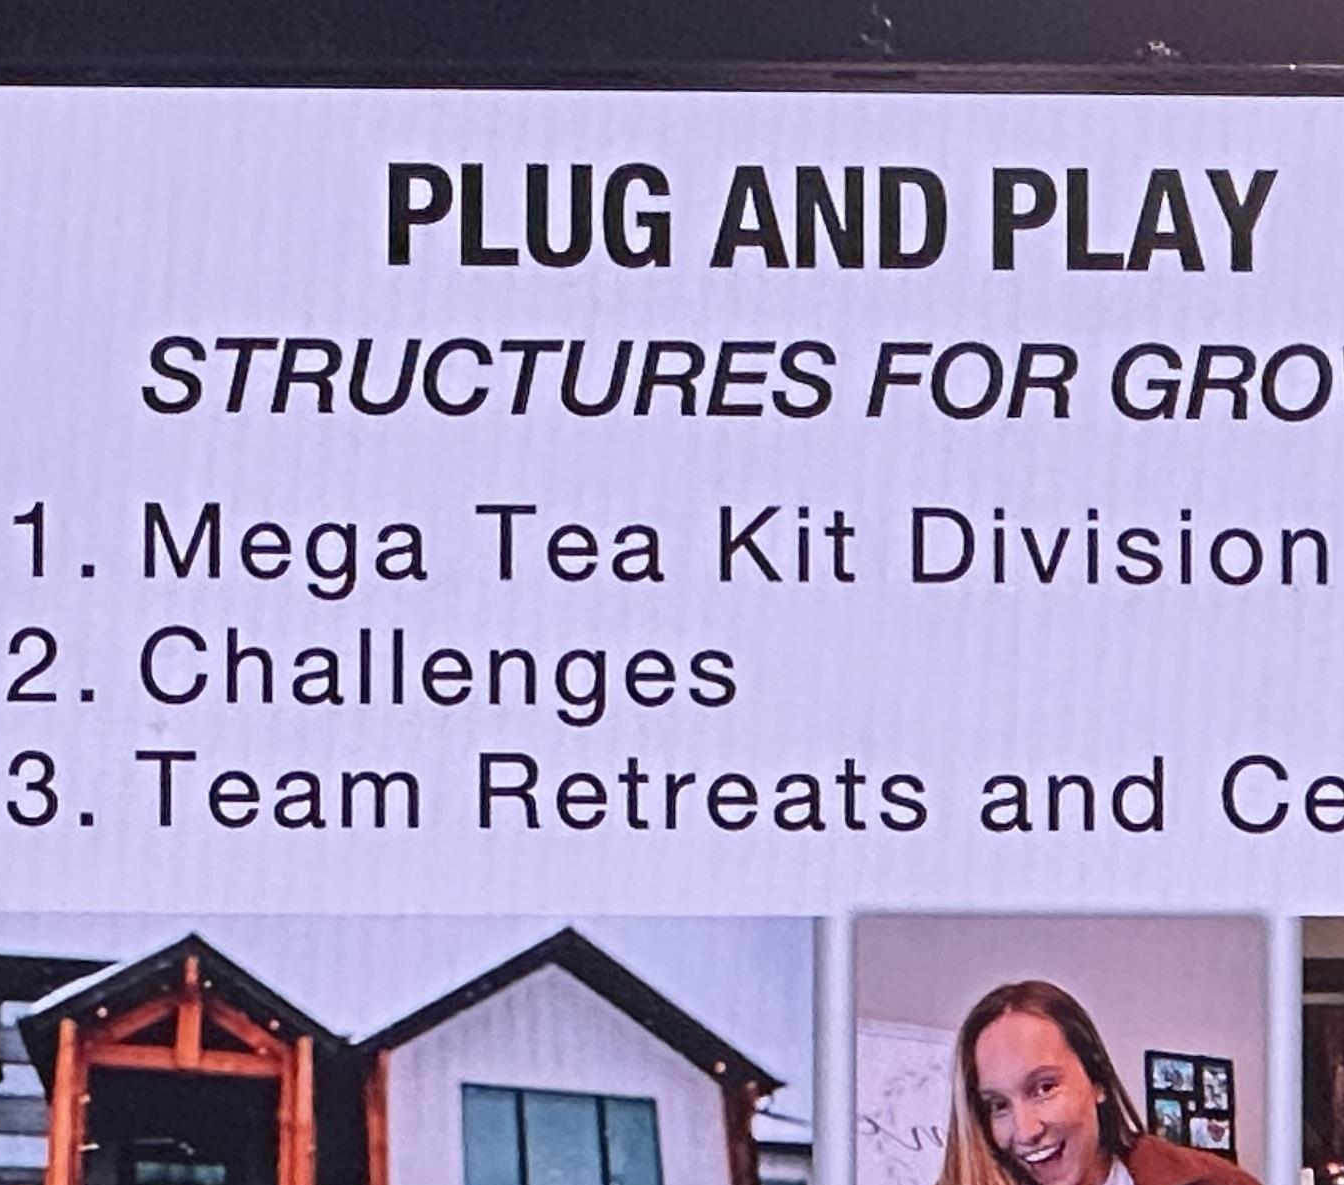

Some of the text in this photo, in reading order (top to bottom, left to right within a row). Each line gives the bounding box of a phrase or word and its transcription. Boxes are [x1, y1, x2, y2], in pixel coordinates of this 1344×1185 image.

[388, 162, 1279, 273] PLUG AND PLAY
[141, 335, 837, 418] STRUCTURES
[866, 341, 1079, 420] FOR
[13, 501, 95, 578] 1.
[144, 502, 428, 601] Mega
[475, 504, 665, 583] Tea
[719, 505, 856, 583] Kit
[912, 507, 1328, 586] Division
[6, 625, 737, 727] 2. Challenges
[6, 750, 94, 827] 3.
[135, 750, 419, 829] Team
[479, 752, 927, 832] Retreats
[980, 755, 1164, 833] and
